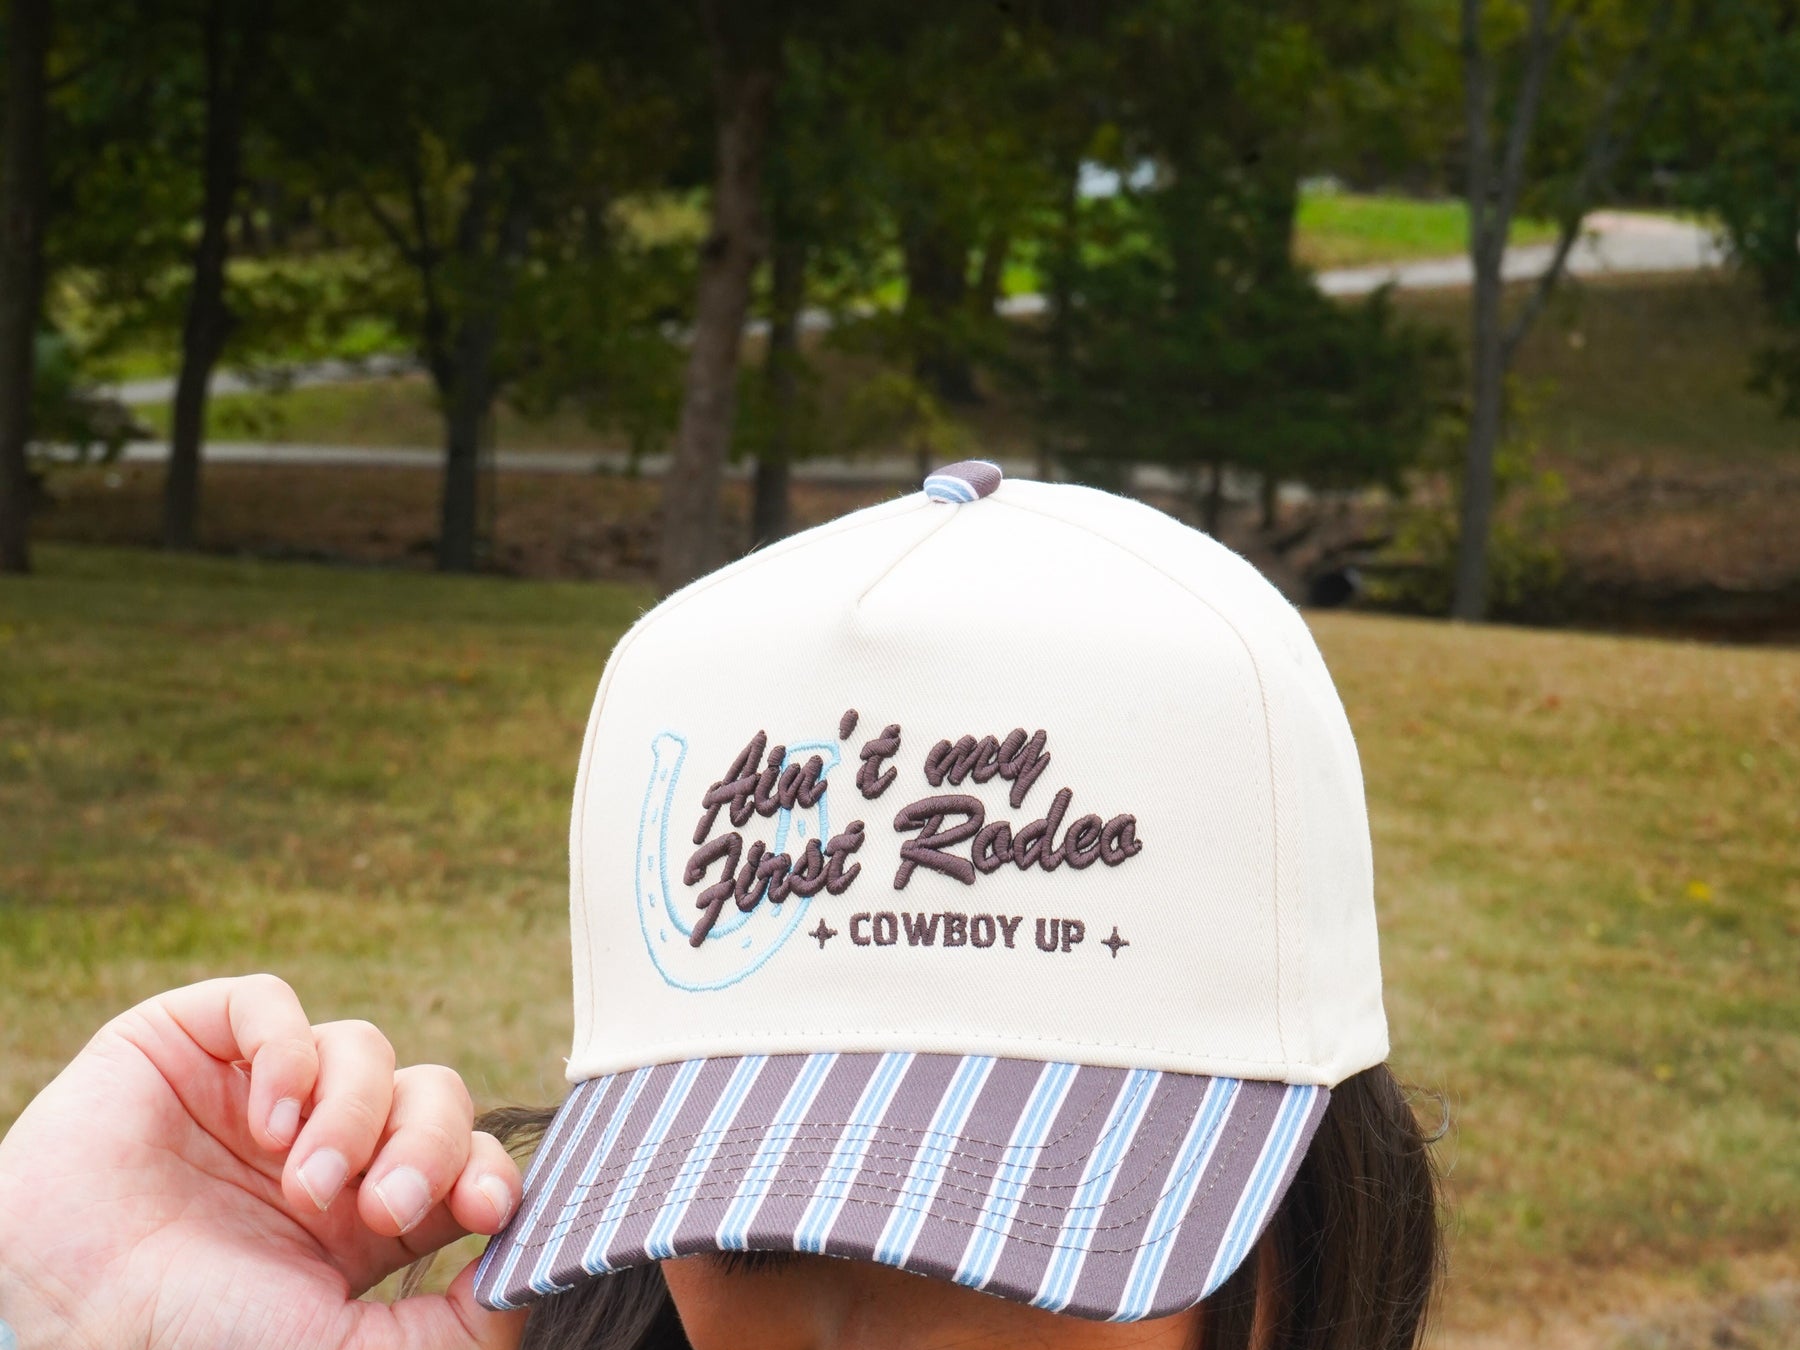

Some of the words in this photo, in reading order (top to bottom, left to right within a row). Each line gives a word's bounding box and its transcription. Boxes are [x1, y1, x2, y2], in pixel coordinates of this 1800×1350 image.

[693, 709, 901, 845] Ain't
[923, 728, 1051, 809] my
[683, 820, 866, 948] First
[893, 787, 1143, 891] Rodeo
[849, 911, 1024, 949] COWBOY
[1035, 918, 1086, 953] UP
